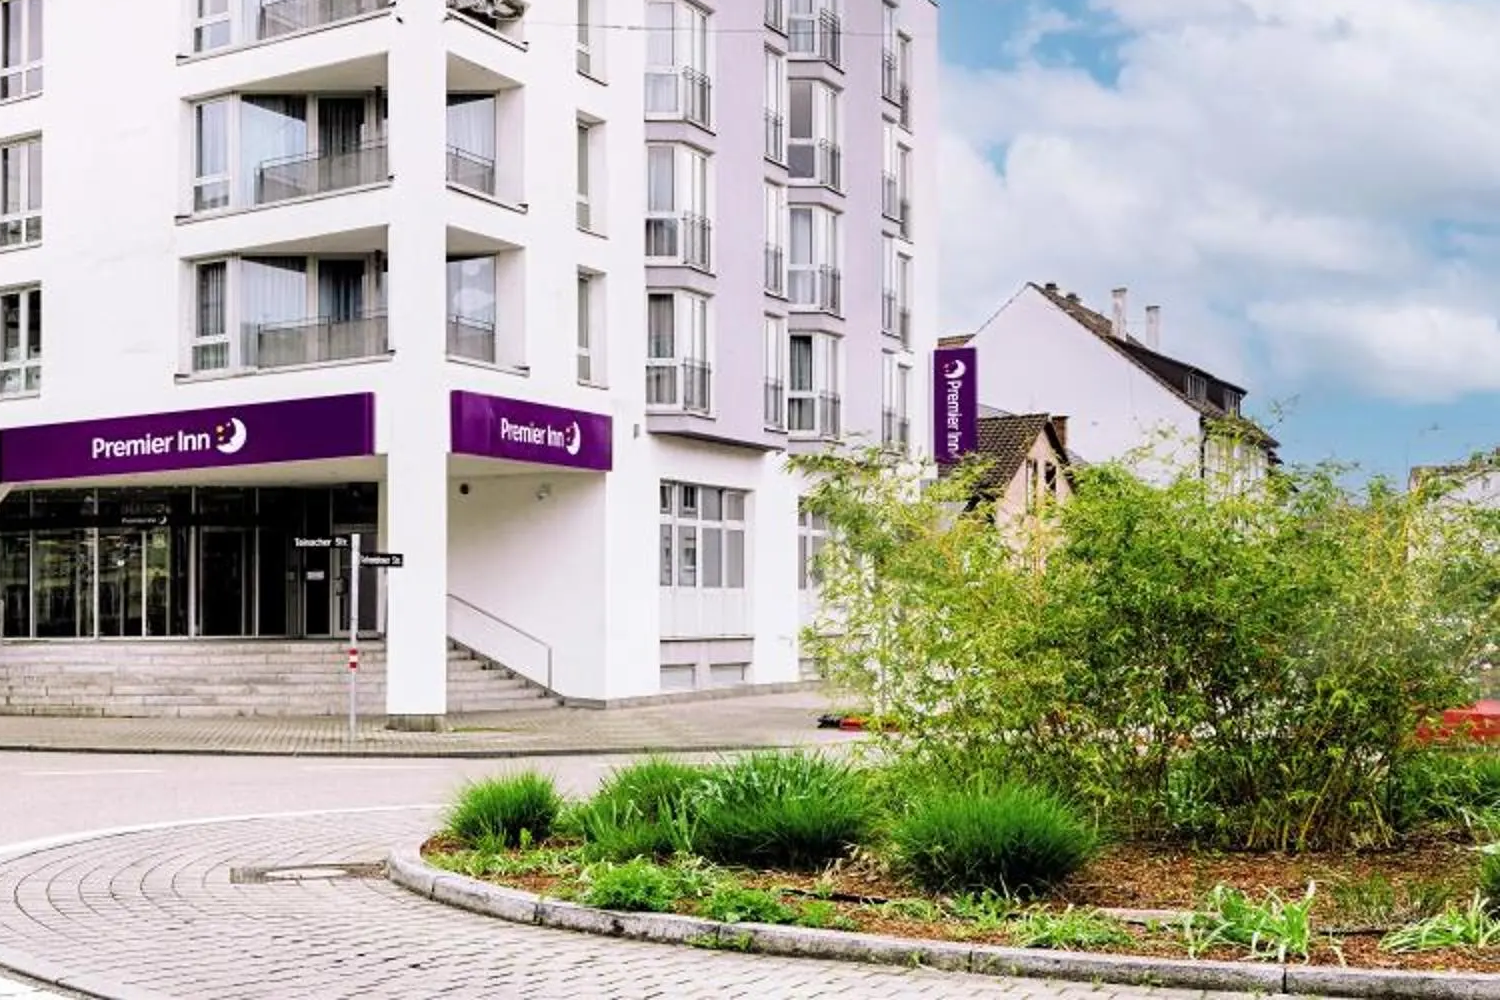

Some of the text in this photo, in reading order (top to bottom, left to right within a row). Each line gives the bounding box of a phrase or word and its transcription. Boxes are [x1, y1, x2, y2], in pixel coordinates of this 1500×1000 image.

[947, 380, 962, 452] Premier Inn
[92, 430, 210, 459] Premier Inn
[501, 417, 564, 449] Premier Inn
